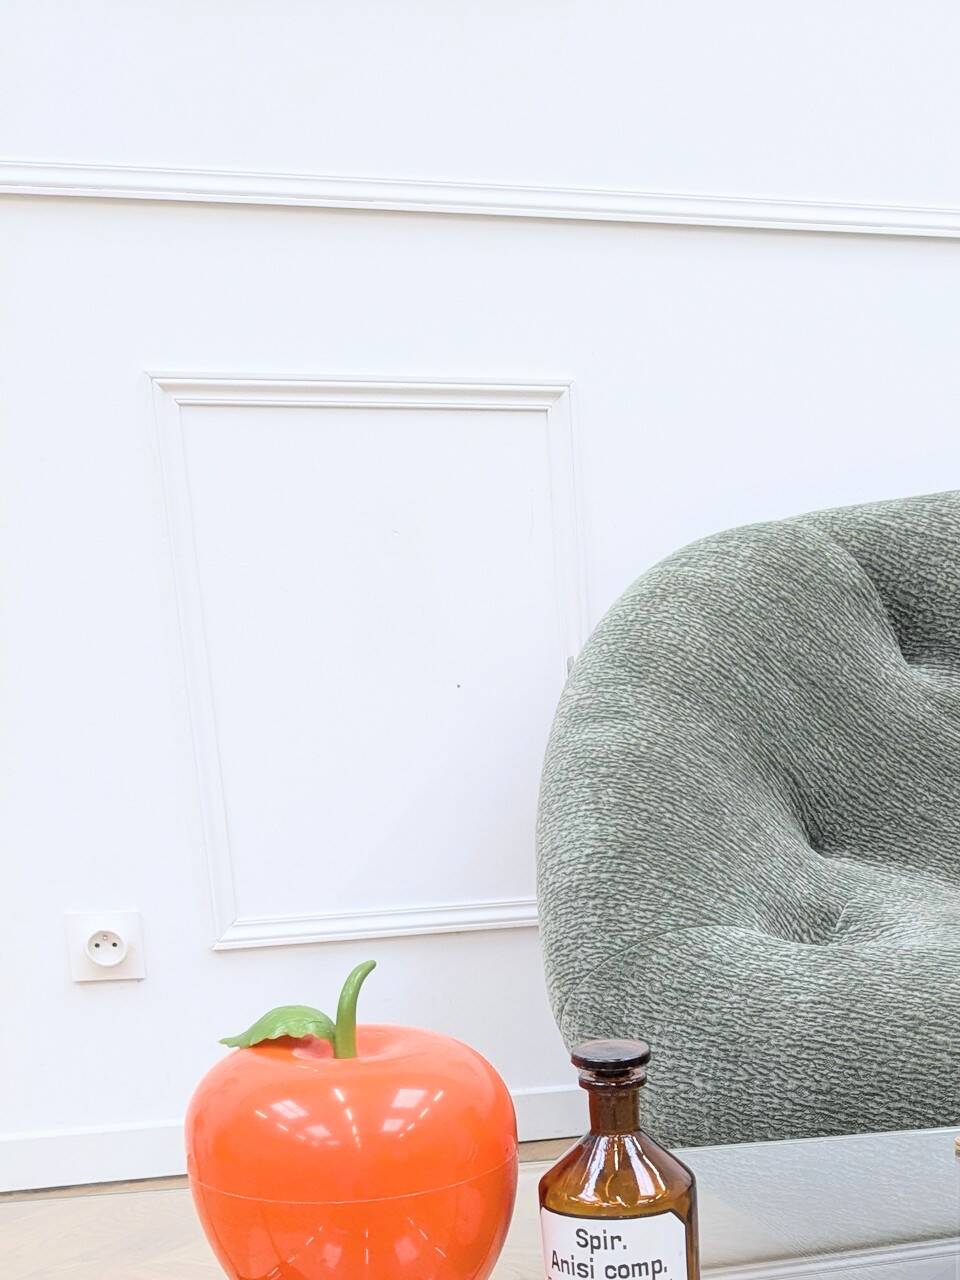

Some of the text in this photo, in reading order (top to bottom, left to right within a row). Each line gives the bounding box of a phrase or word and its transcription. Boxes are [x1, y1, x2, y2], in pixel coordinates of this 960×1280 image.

[575, 1228, 627, 1254] Spir.
[551, 1250, 668, 1280] Anisi comp.
